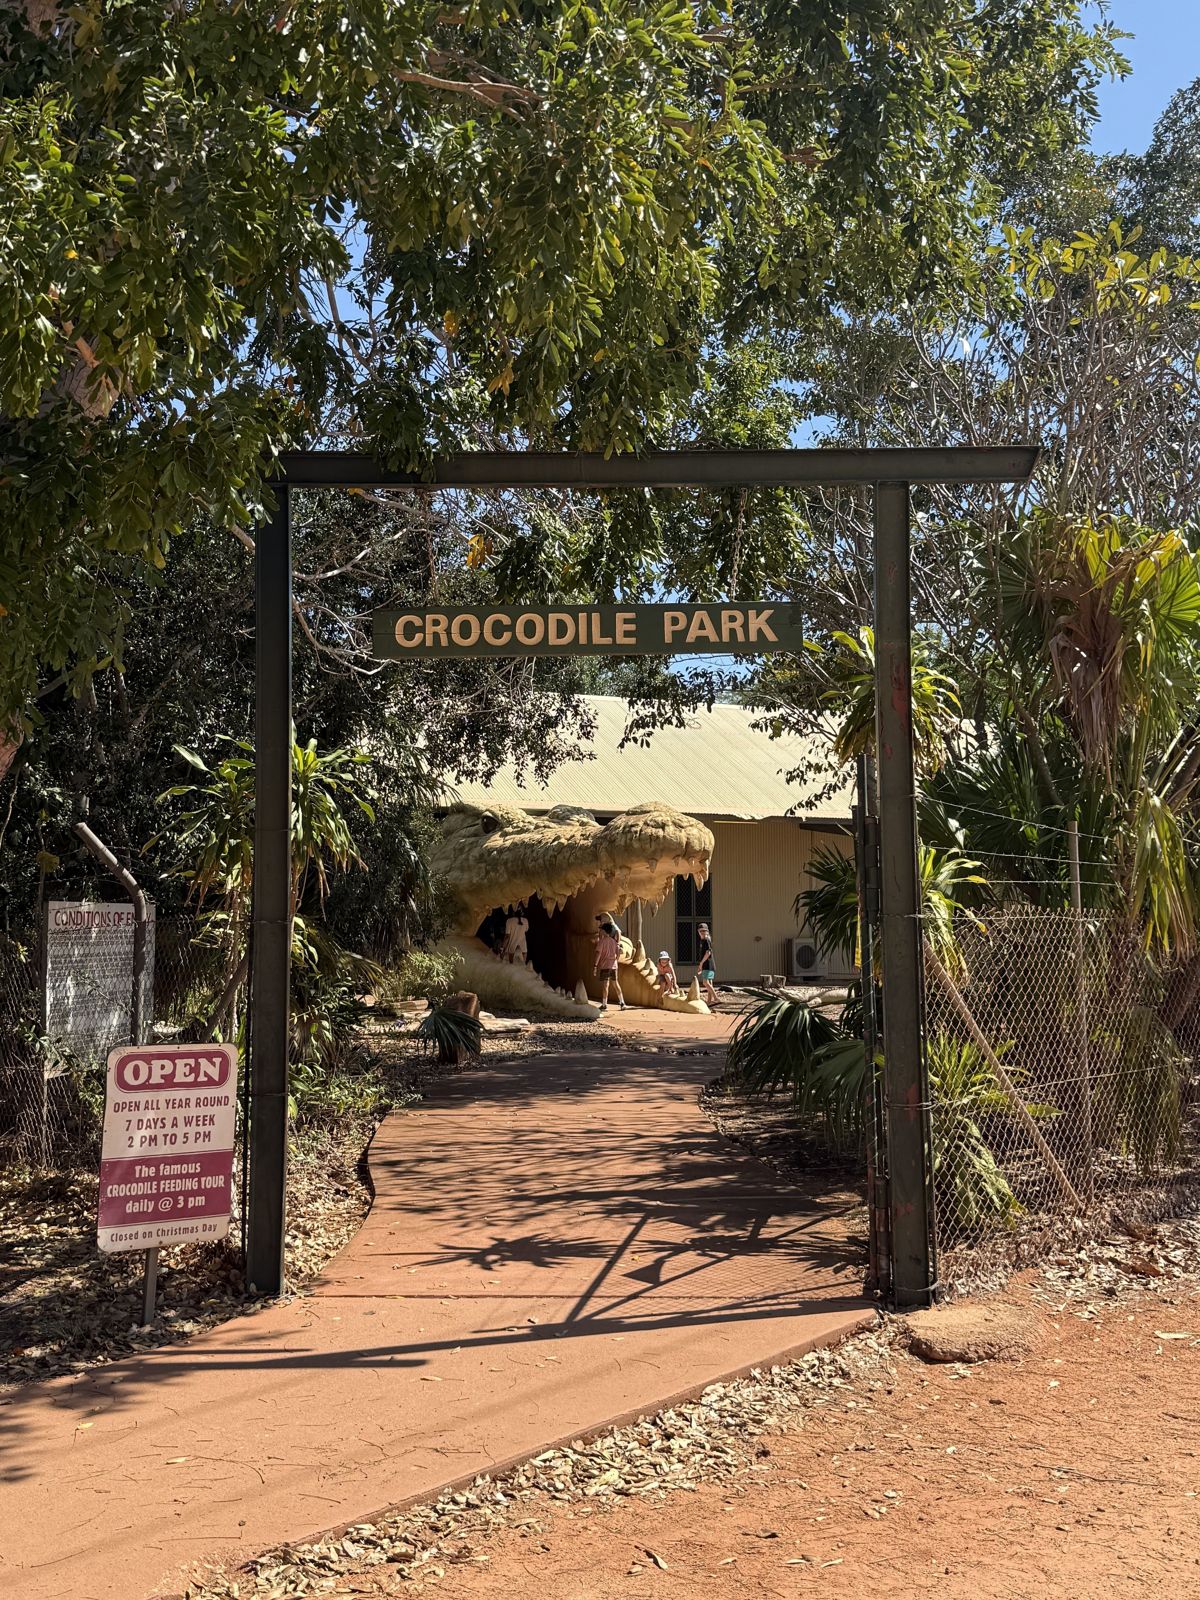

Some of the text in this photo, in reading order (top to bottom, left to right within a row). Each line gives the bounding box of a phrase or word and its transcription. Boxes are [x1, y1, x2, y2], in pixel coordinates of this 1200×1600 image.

[395, 608, 779, 648] CROCODILE PARK
[54, 910, 151, 927] CONDITIONS OF ENY
[123, 1057, 222, 1086] OPEN
[113, 1095, 230, 1113] OPEN ALL YEAR ROUND
[125, 1114, 216, 1131] 7 DAYS A WEEK
[127, 1131, 211, 1148] 2 PM TO 5 PM
[134, 1162, 201, 1178] The famous
[107, 1175, 225, 1197] CROCODILE FEEDING TOUR
[125, 1195, 206, 1213] daily @ 3 pm
[110, 1223, 218, 1242] Closed on Christmas Day
